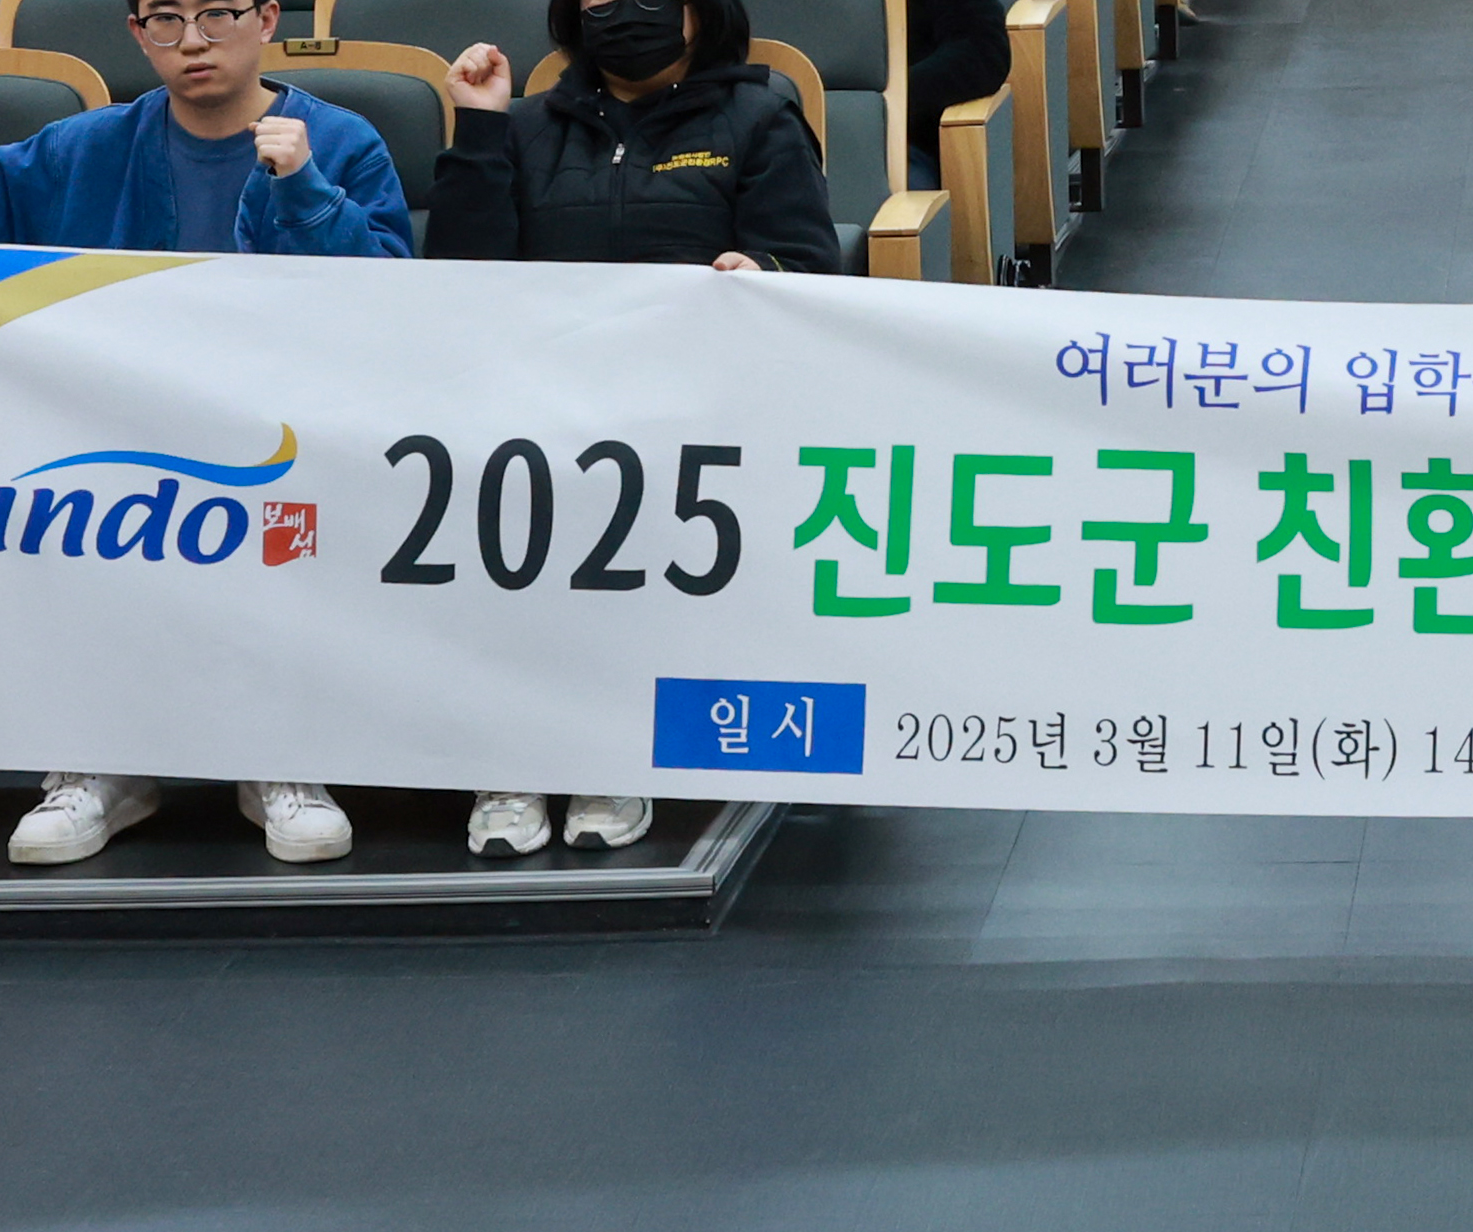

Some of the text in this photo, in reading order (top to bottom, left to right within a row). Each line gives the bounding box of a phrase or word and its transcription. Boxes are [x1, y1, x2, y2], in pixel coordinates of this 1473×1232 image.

[299, 40, 322, 51] A-8
[1056, 332, 1312, 414] 여러분의
[380, 434, 742, 597] 2025
[793, 444, 1210, 626] 진도군
[895, 711, 1068, 770] 2025년
[1093, 714, 1168, 773] 3월
[1196, 717, 1397, 780] 11일(화)
